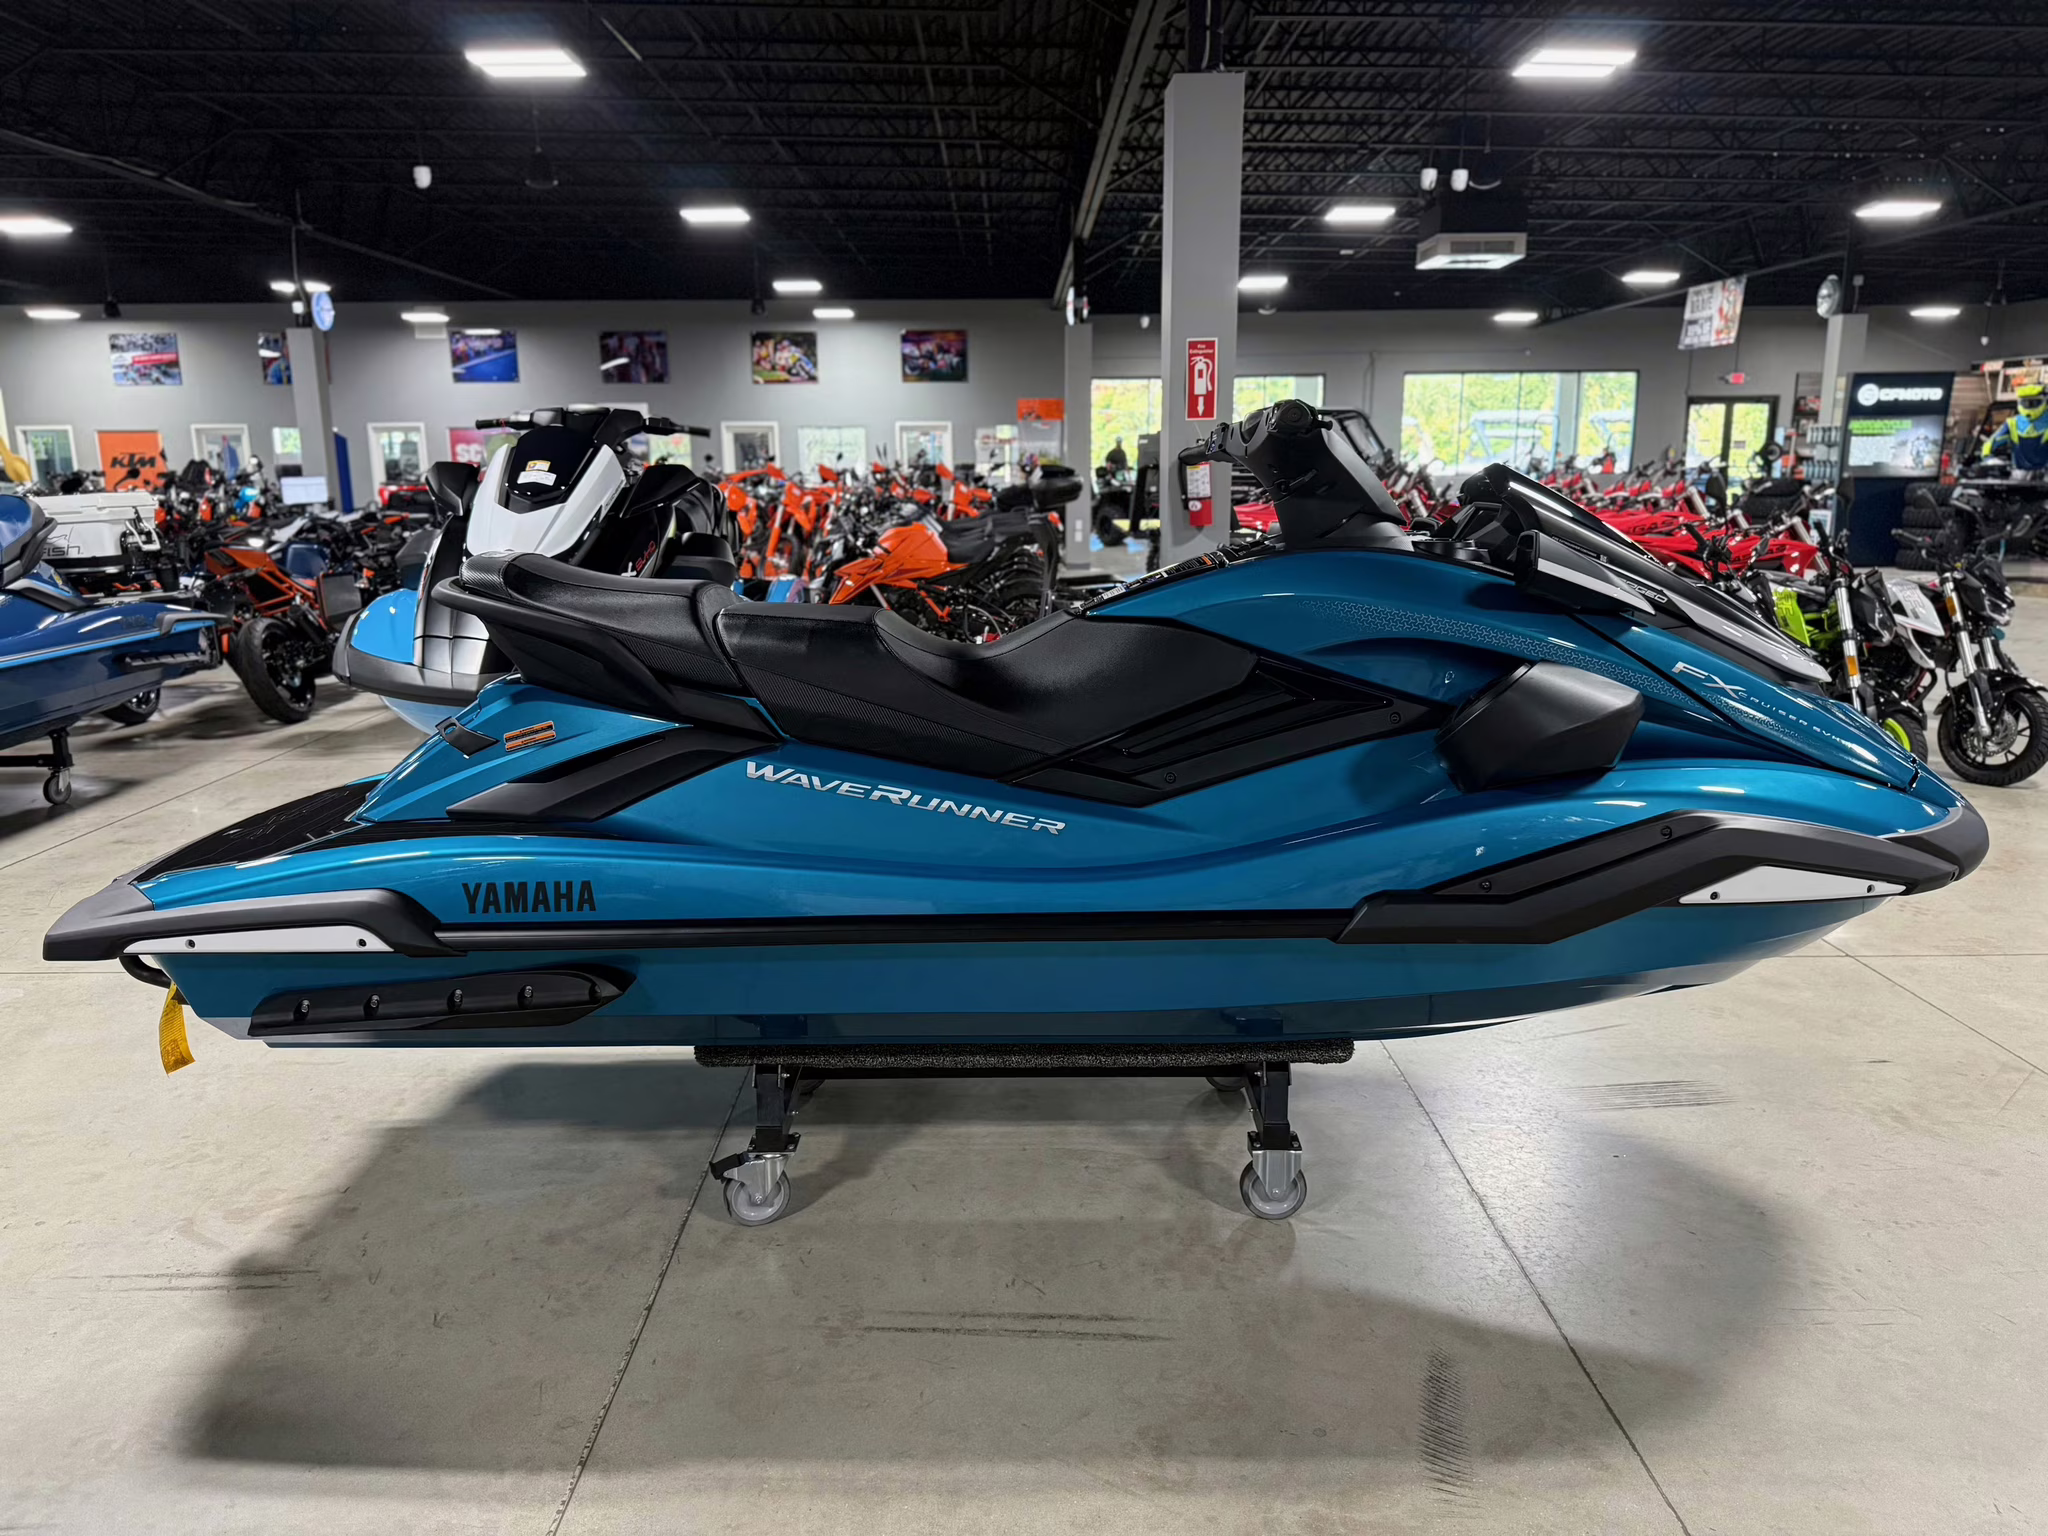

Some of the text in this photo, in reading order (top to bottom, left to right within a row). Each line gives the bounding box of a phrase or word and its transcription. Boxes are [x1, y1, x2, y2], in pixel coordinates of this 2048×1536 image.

[111, 453, 156, 468] KTM
[1672, 661, 1746, 699] FX
[1738, 691, 1808, 726] CRUISER
[462, 880, 596, 914] YAMAHA
